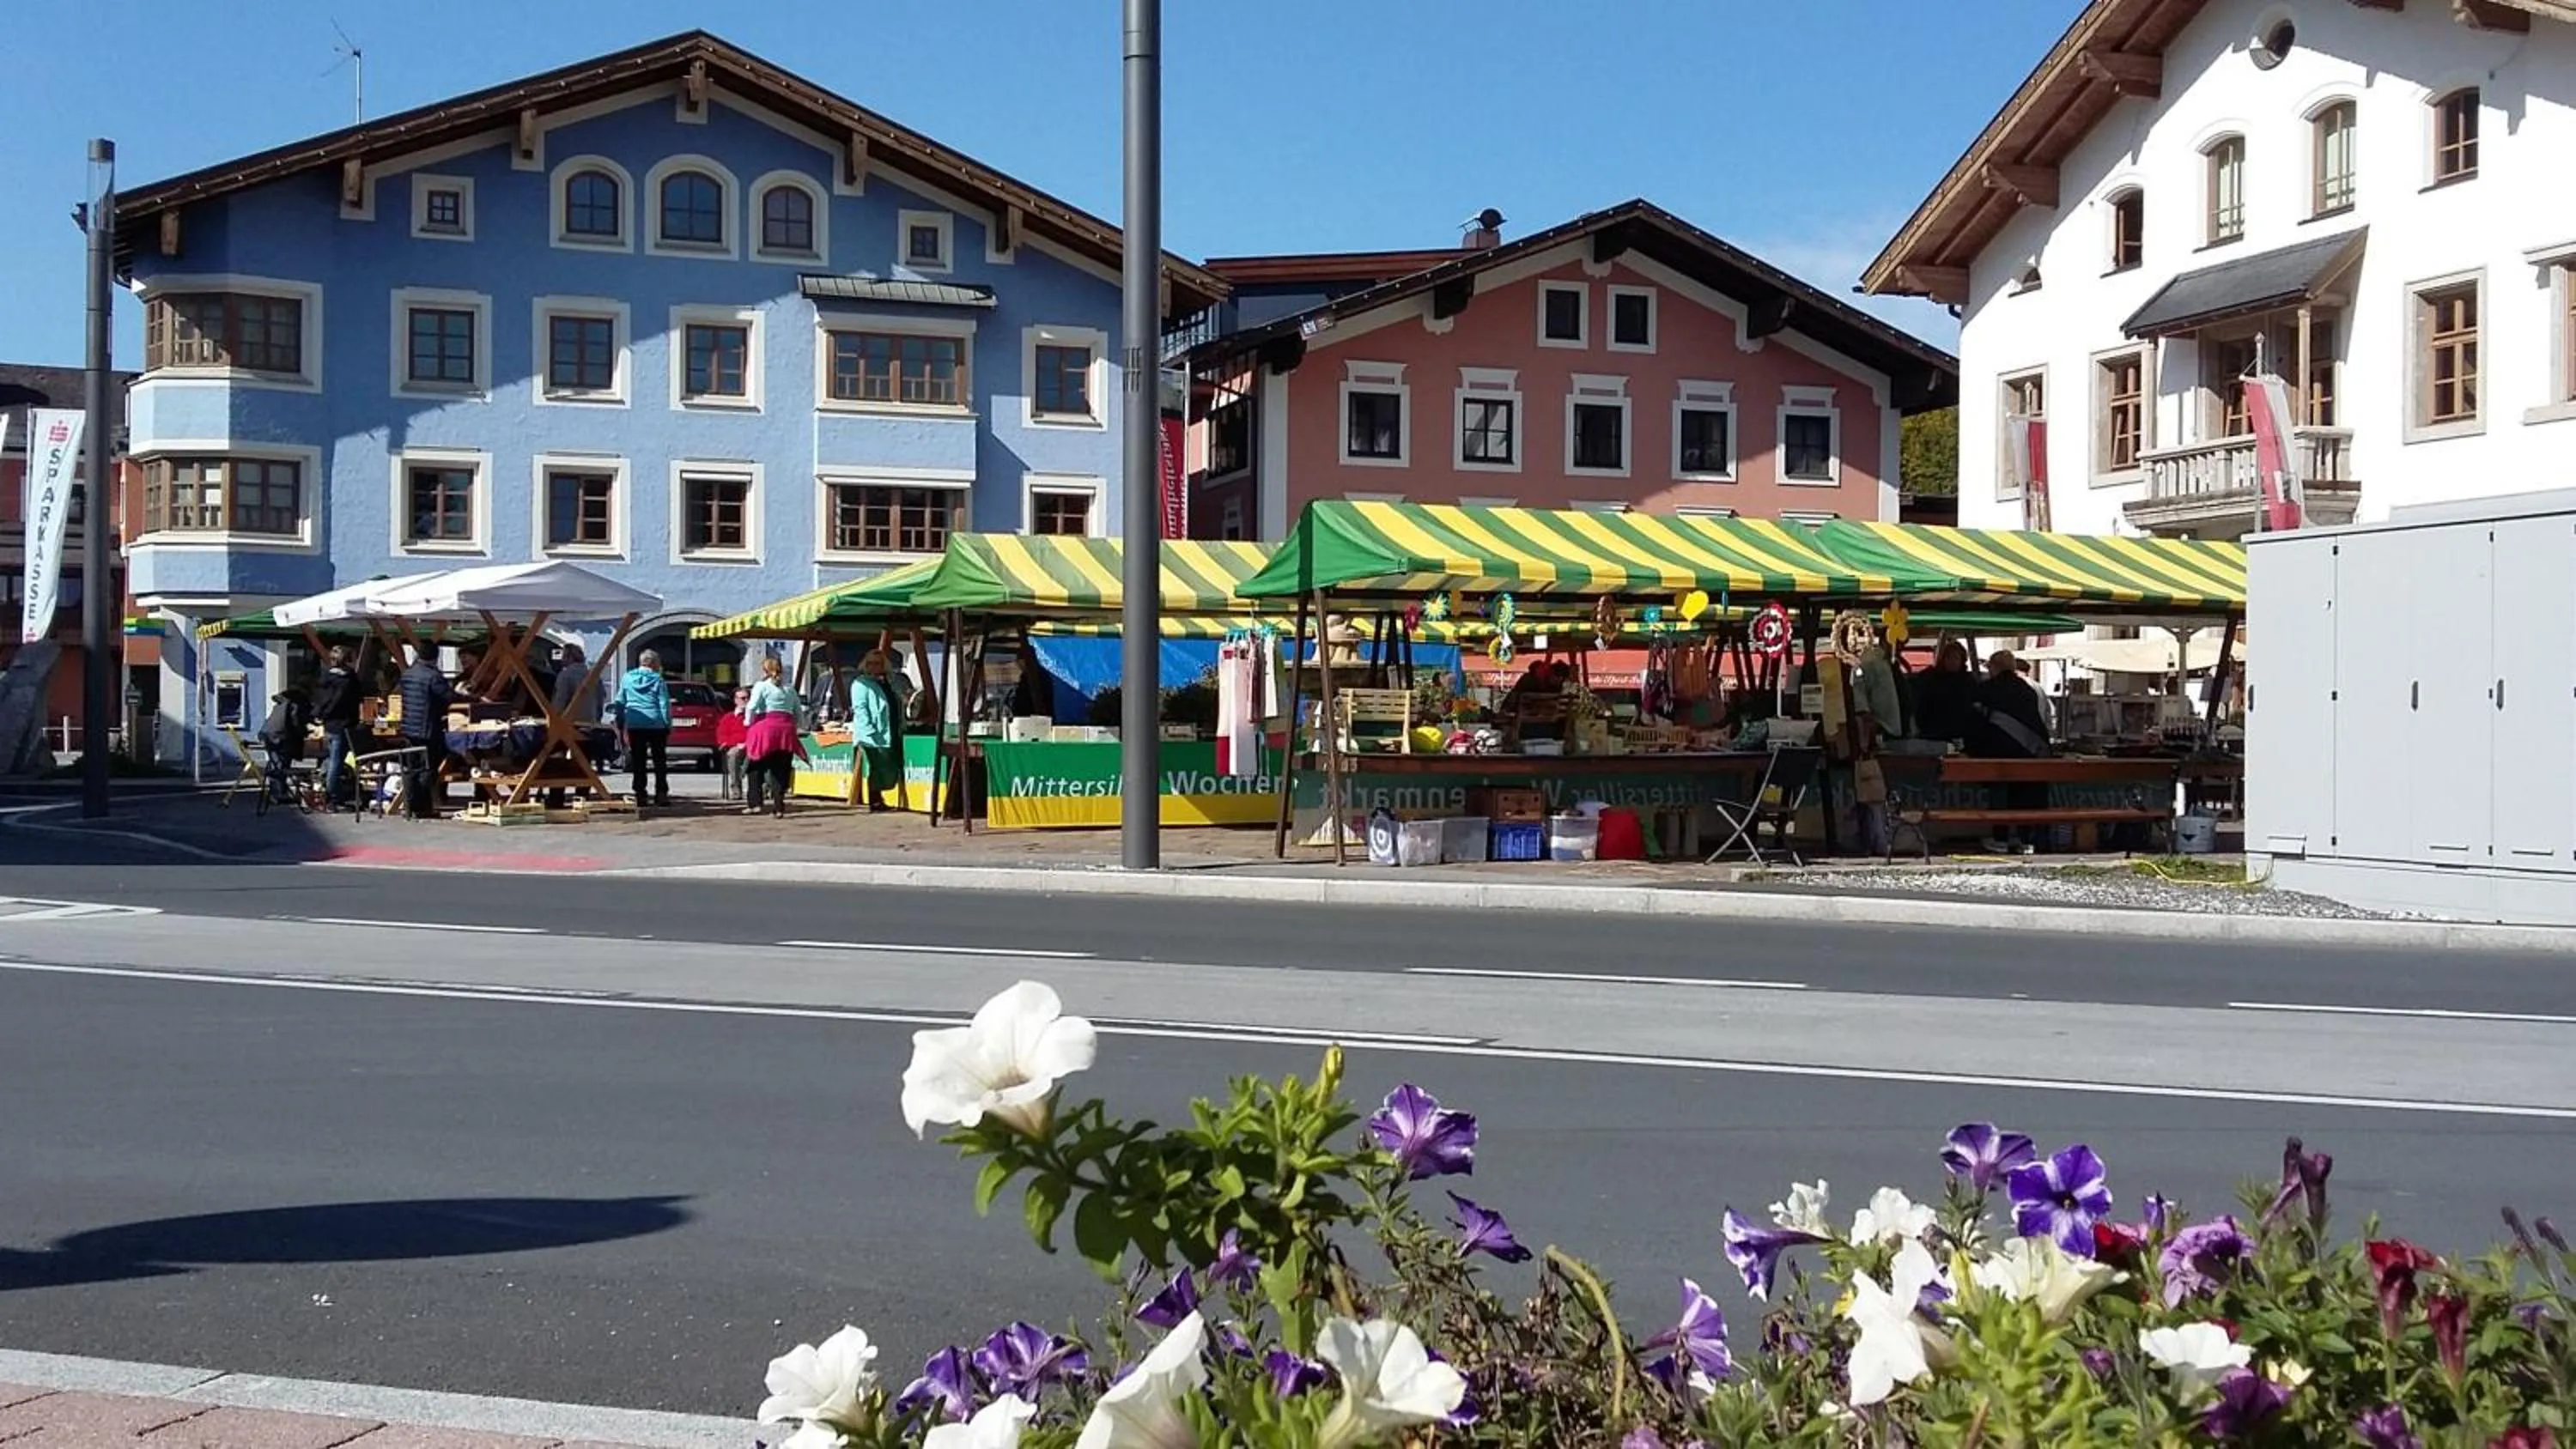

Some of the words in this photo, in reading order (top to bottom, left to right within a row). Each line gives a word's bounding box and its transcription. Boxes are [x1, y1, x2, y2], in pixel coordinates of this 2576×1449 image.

[27, 448, 61, 621] SPARKASSE
[1010, 775, 1122, 797] Mittersil
[1167, 771, 1286, 795] Wochen
